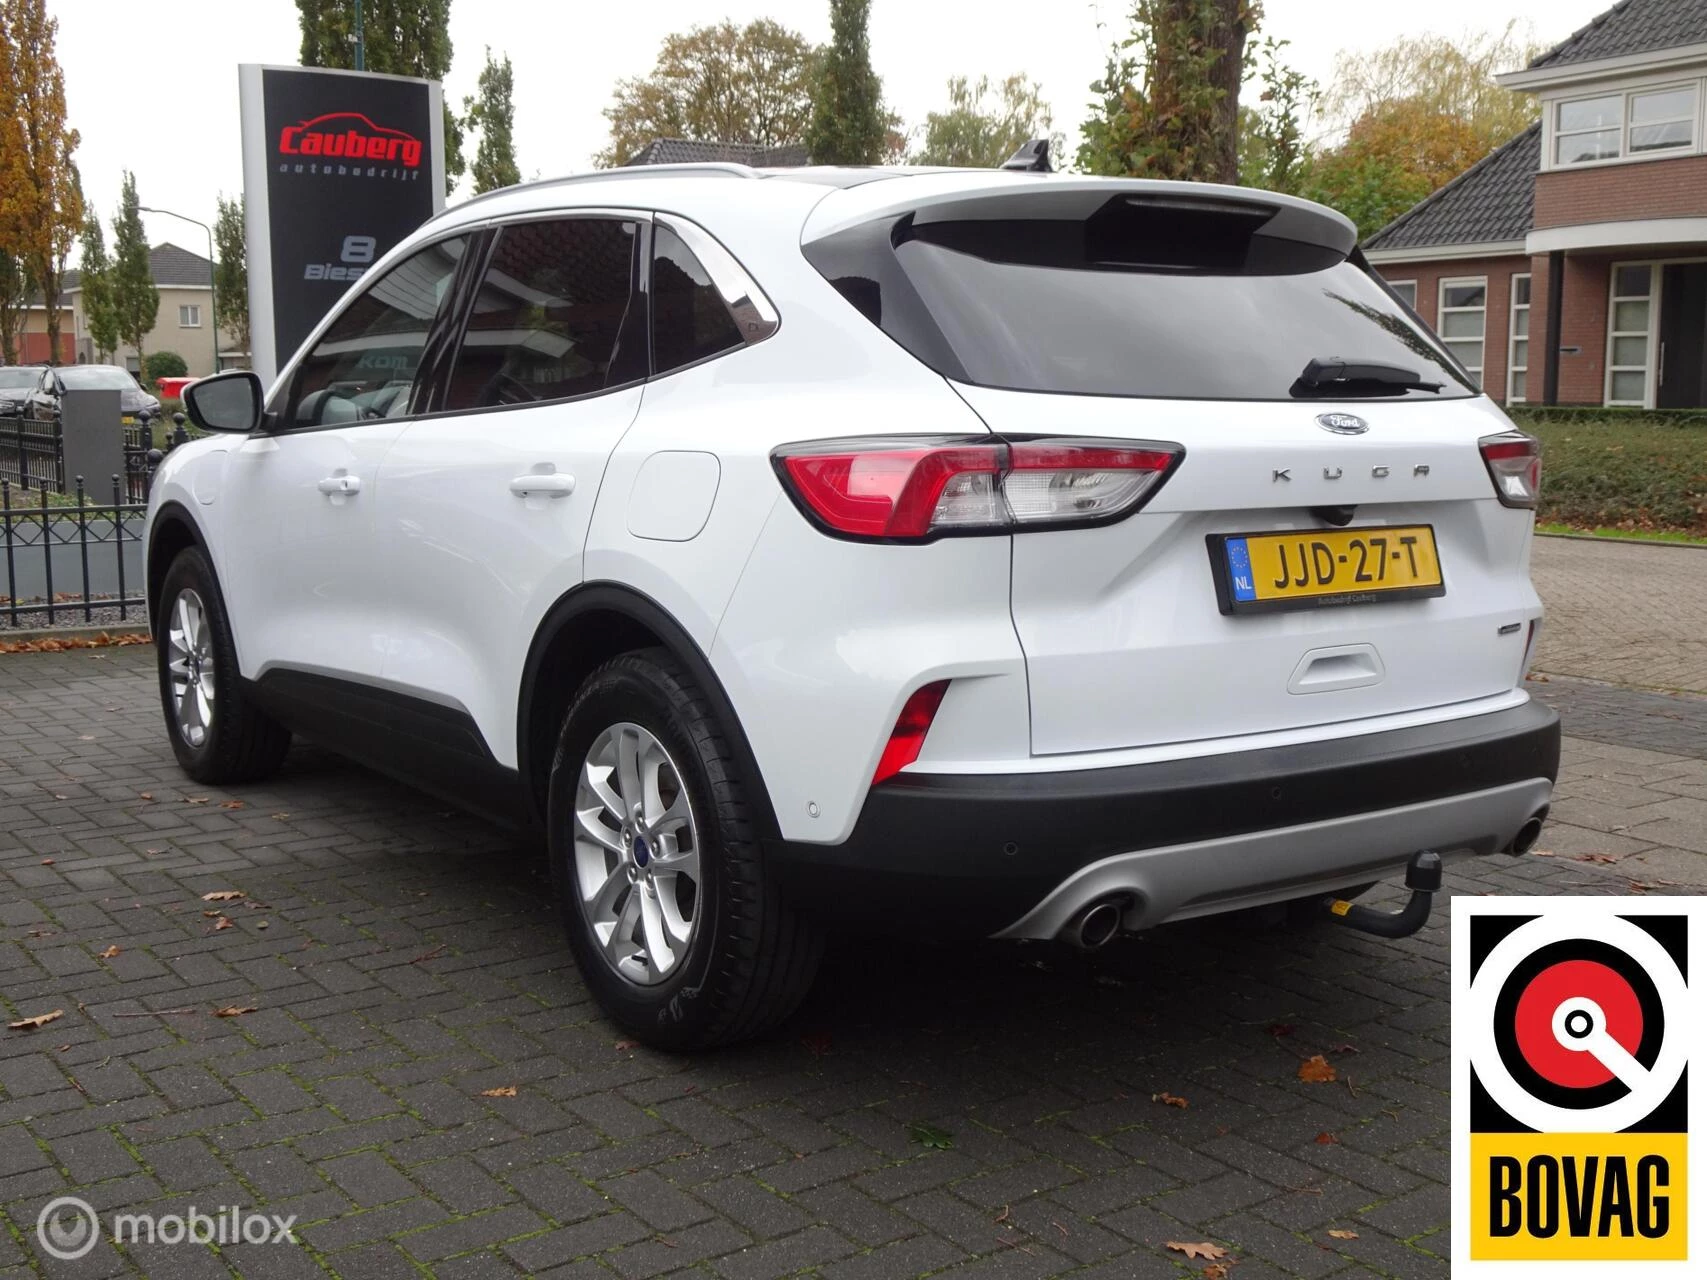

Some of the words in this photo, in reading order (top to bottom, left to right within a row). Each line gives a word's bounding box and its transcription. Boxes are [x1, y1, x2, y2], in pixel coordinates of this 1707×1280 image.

[279, 126, 421, 167] Cauberg
[280, 163, 419, 180] autobedrijf
[304, 263, 369, 281] Bies
[1330, 414, 1361, 428] Ford
[1272, 464, 1430, 482] KUGA
[1274, 536, 1418, 589] JJD-27-T
[1235, 576, 1252, 591] NL
